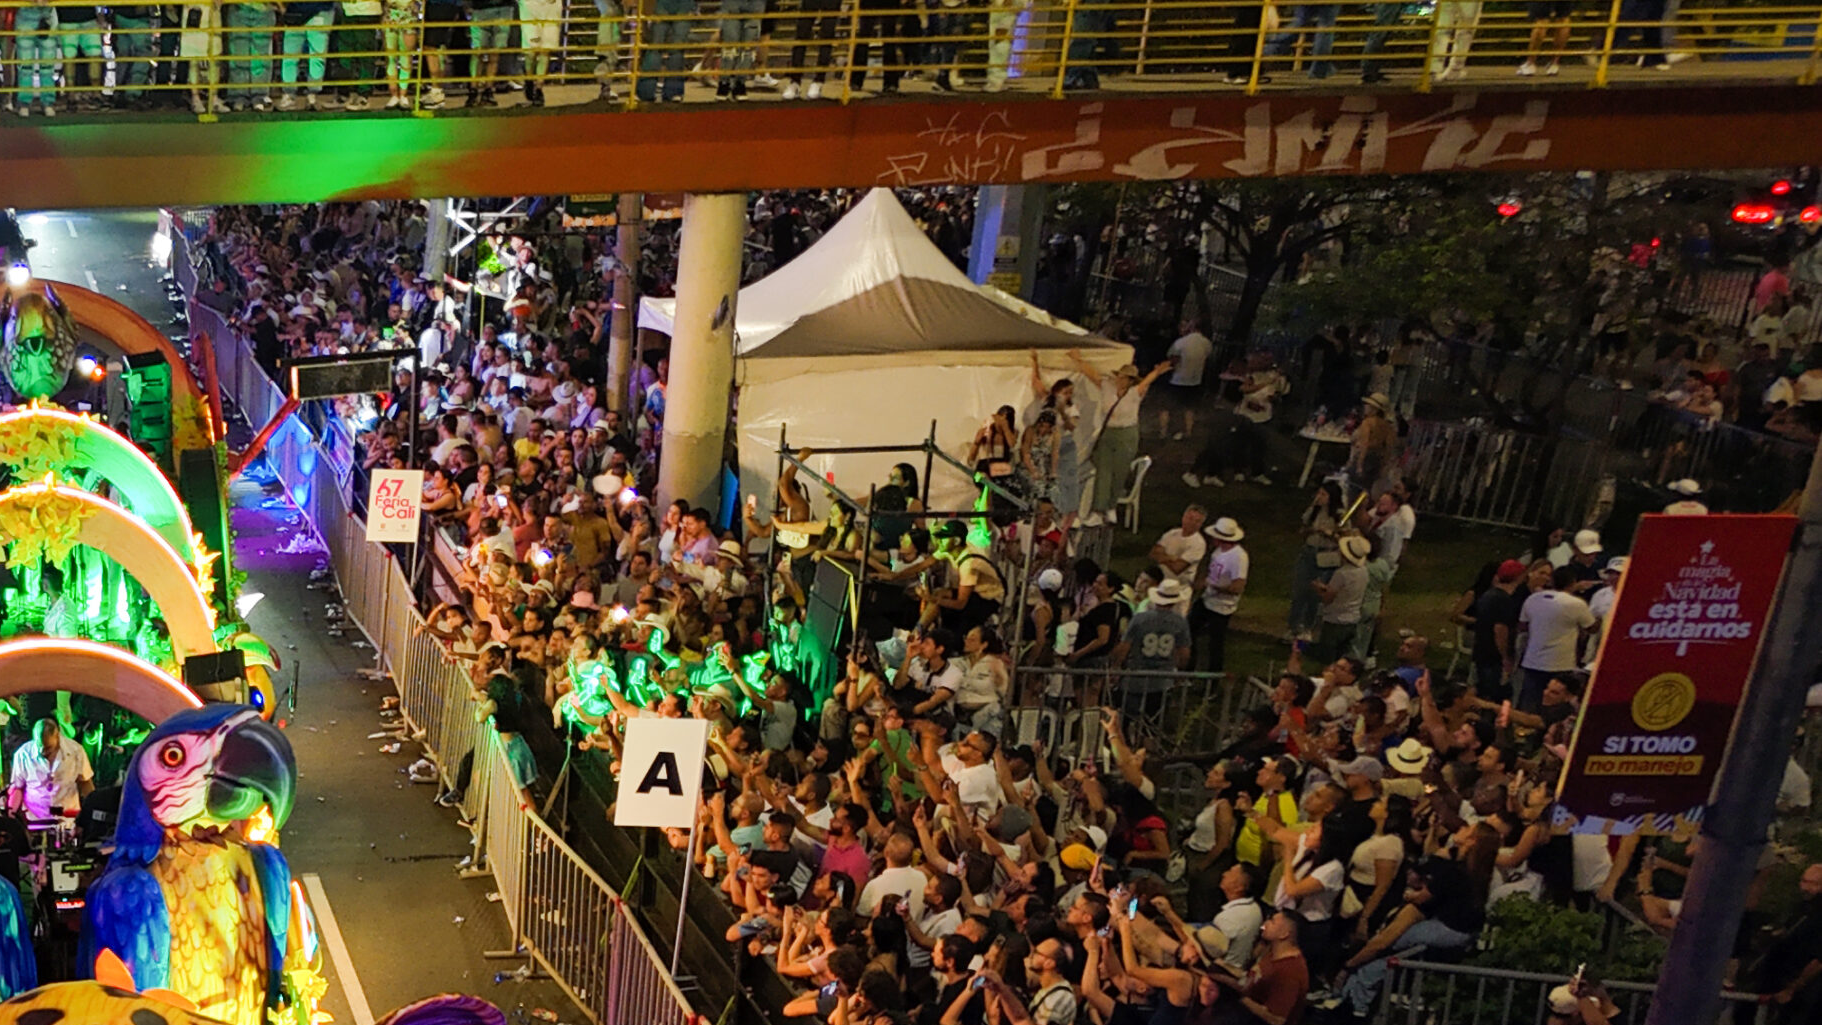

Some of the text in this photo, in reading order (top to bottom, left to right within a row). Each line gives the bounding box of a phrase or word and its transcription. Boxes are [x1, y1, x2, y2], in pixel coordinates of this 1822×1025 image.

[377, 478, 404, 497] 67
[382, 504, 416, 519] Cali
[1663, 581, 1742, 600] Navidad
[1706, 602, 1739, 618] en
[1629, 619, 1752, 639] cuidarnos
[1141, 632, 1175, 657] 99
[1603, 736, 1696, 753] SI TOMO
[635, 751, 684, 796] A
[1589, 756, 1695, 775] no manejo
